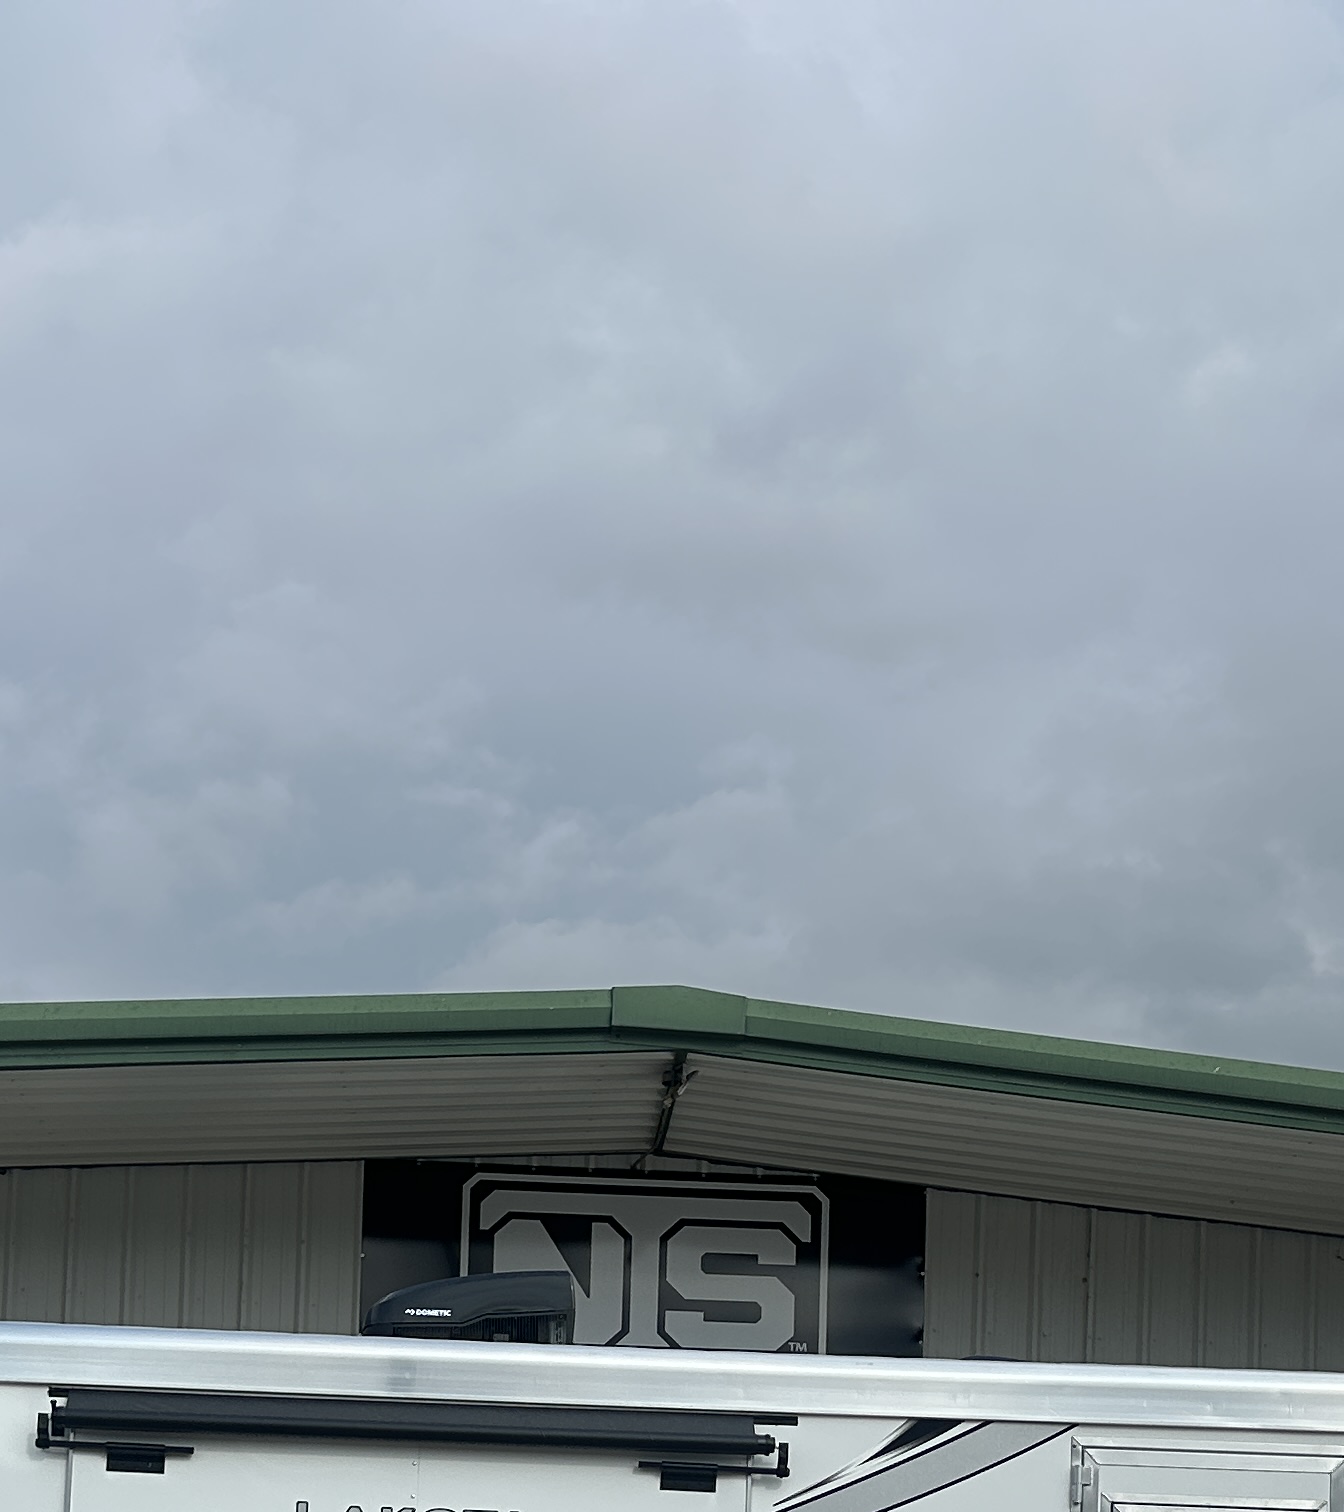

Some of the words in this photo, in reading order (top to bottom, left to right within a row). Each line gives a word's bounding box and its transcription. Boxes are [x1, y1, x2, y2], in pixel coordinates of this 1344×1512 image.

[480, 1189, 811, 1351] NTS
[416, 1308, 452, 1317] DOMETIC
[788, 1341, 807, 1352] TM
